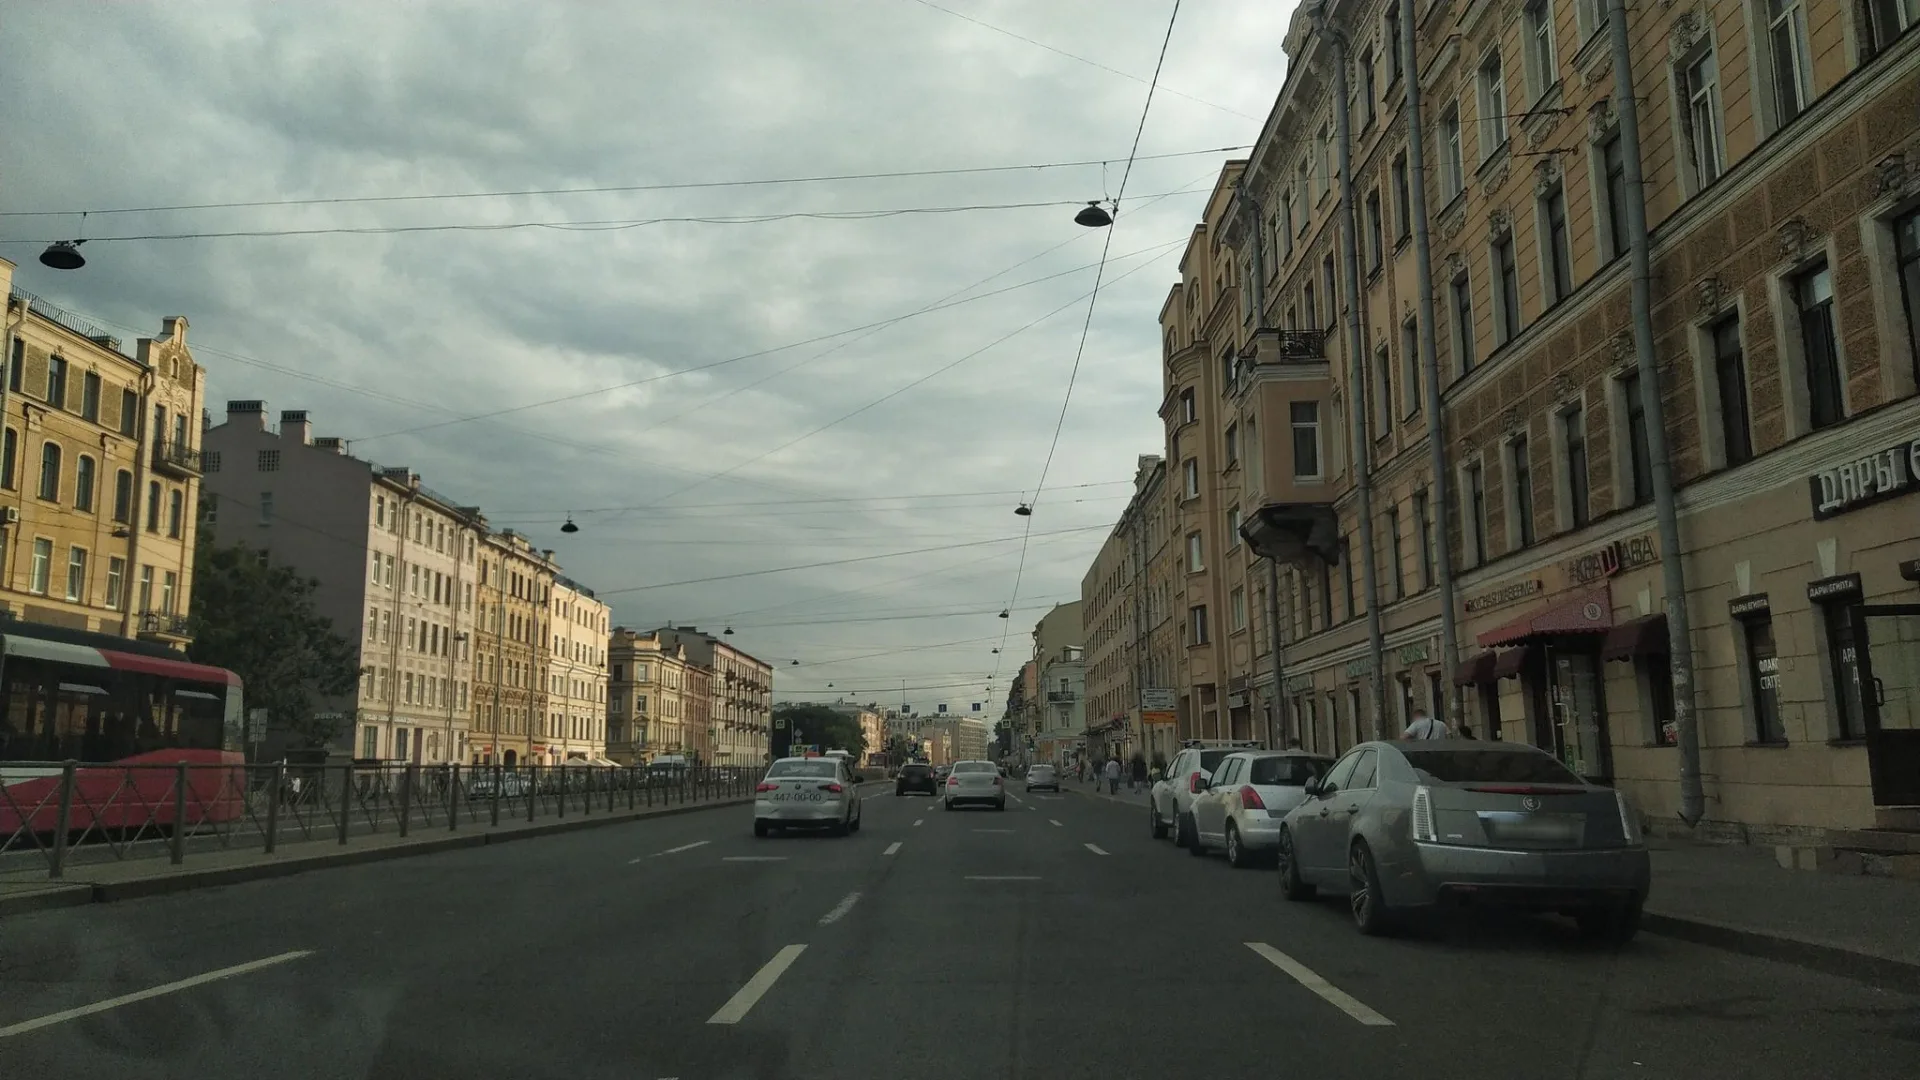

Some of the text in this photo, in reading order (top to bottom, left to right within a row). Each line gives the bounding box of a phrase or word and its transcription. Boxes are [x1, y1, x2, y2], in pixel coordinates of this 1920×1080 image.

[1818, 448, 1908, 512] ДАРЫ
[1809, 586, 1829, 598] ДАРЫ
[773, 792, 822, 803] 447-00-00
